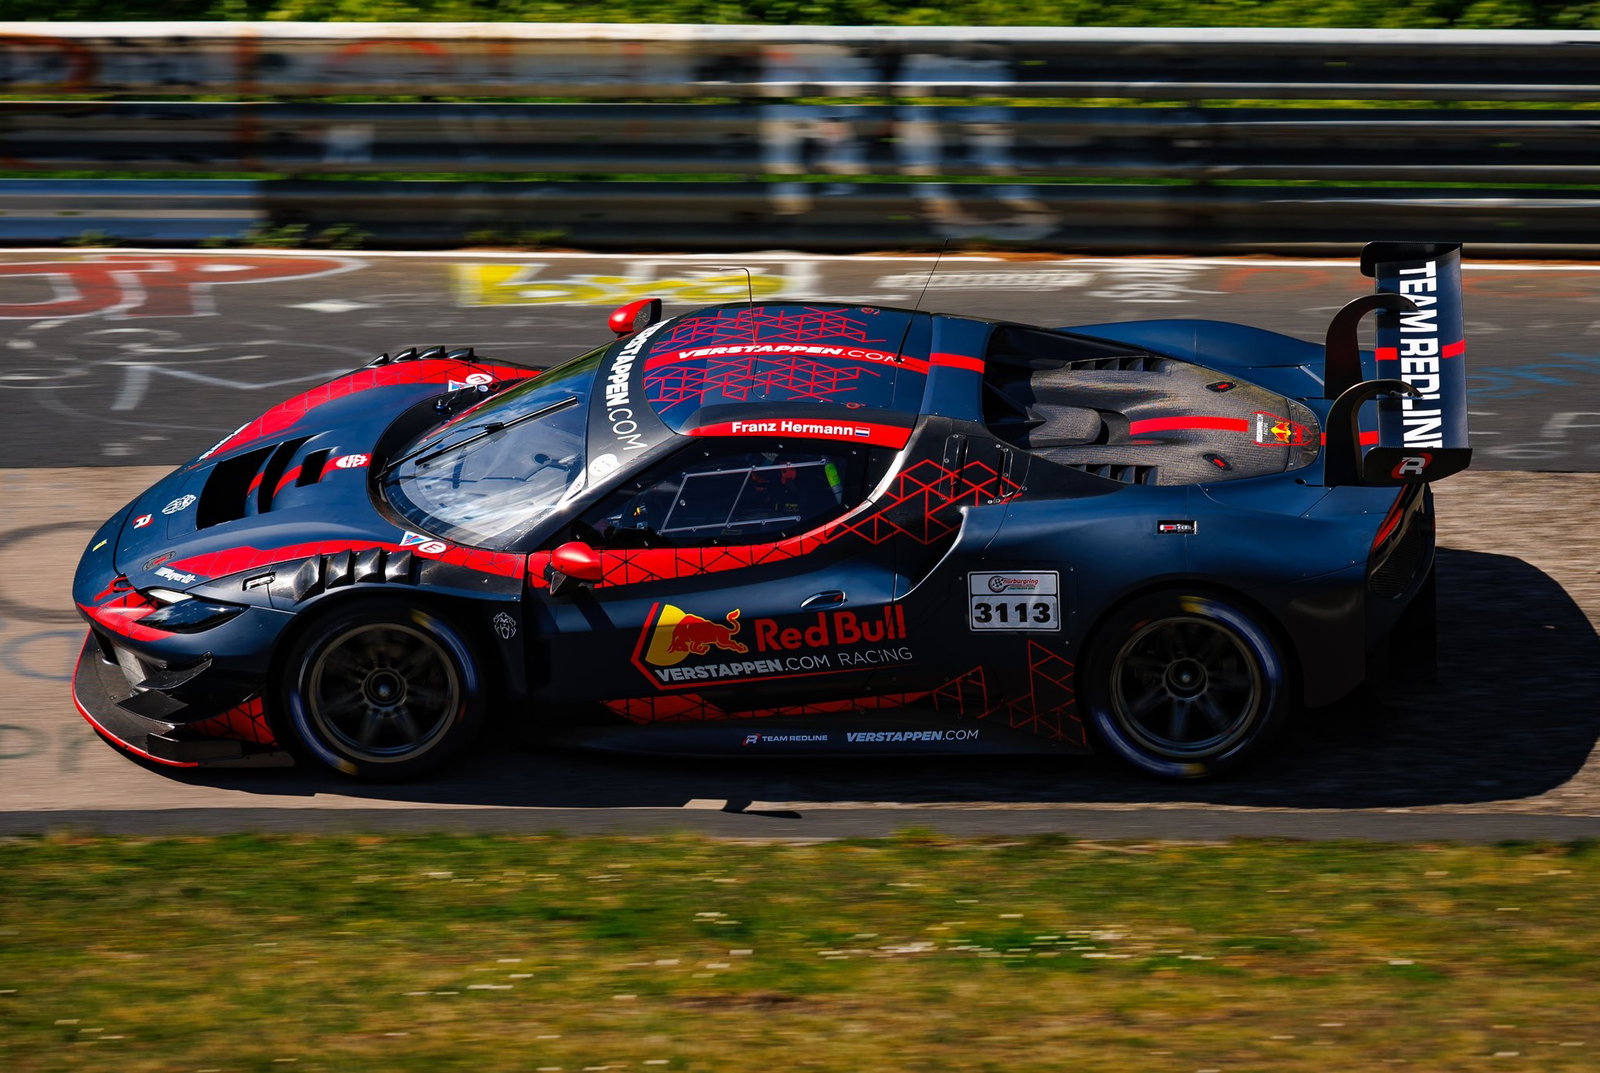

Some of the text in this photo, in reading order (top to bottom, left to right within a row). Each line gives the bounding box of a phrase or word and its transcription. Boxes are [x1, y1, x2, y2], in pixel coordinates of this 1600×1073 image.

[1399, 260, 1443, 449] TEAM REDLIN
[731, 421, 853, 436] Franz Hermann
[974, 602, 1051, 623] 3113
[754, 603, 907, 652] Red Bull
[654, 647, 913, 682] VERSTAPPEN.COM RACING
[846, 729, 979, 743] VERSTAPPEN.COM
